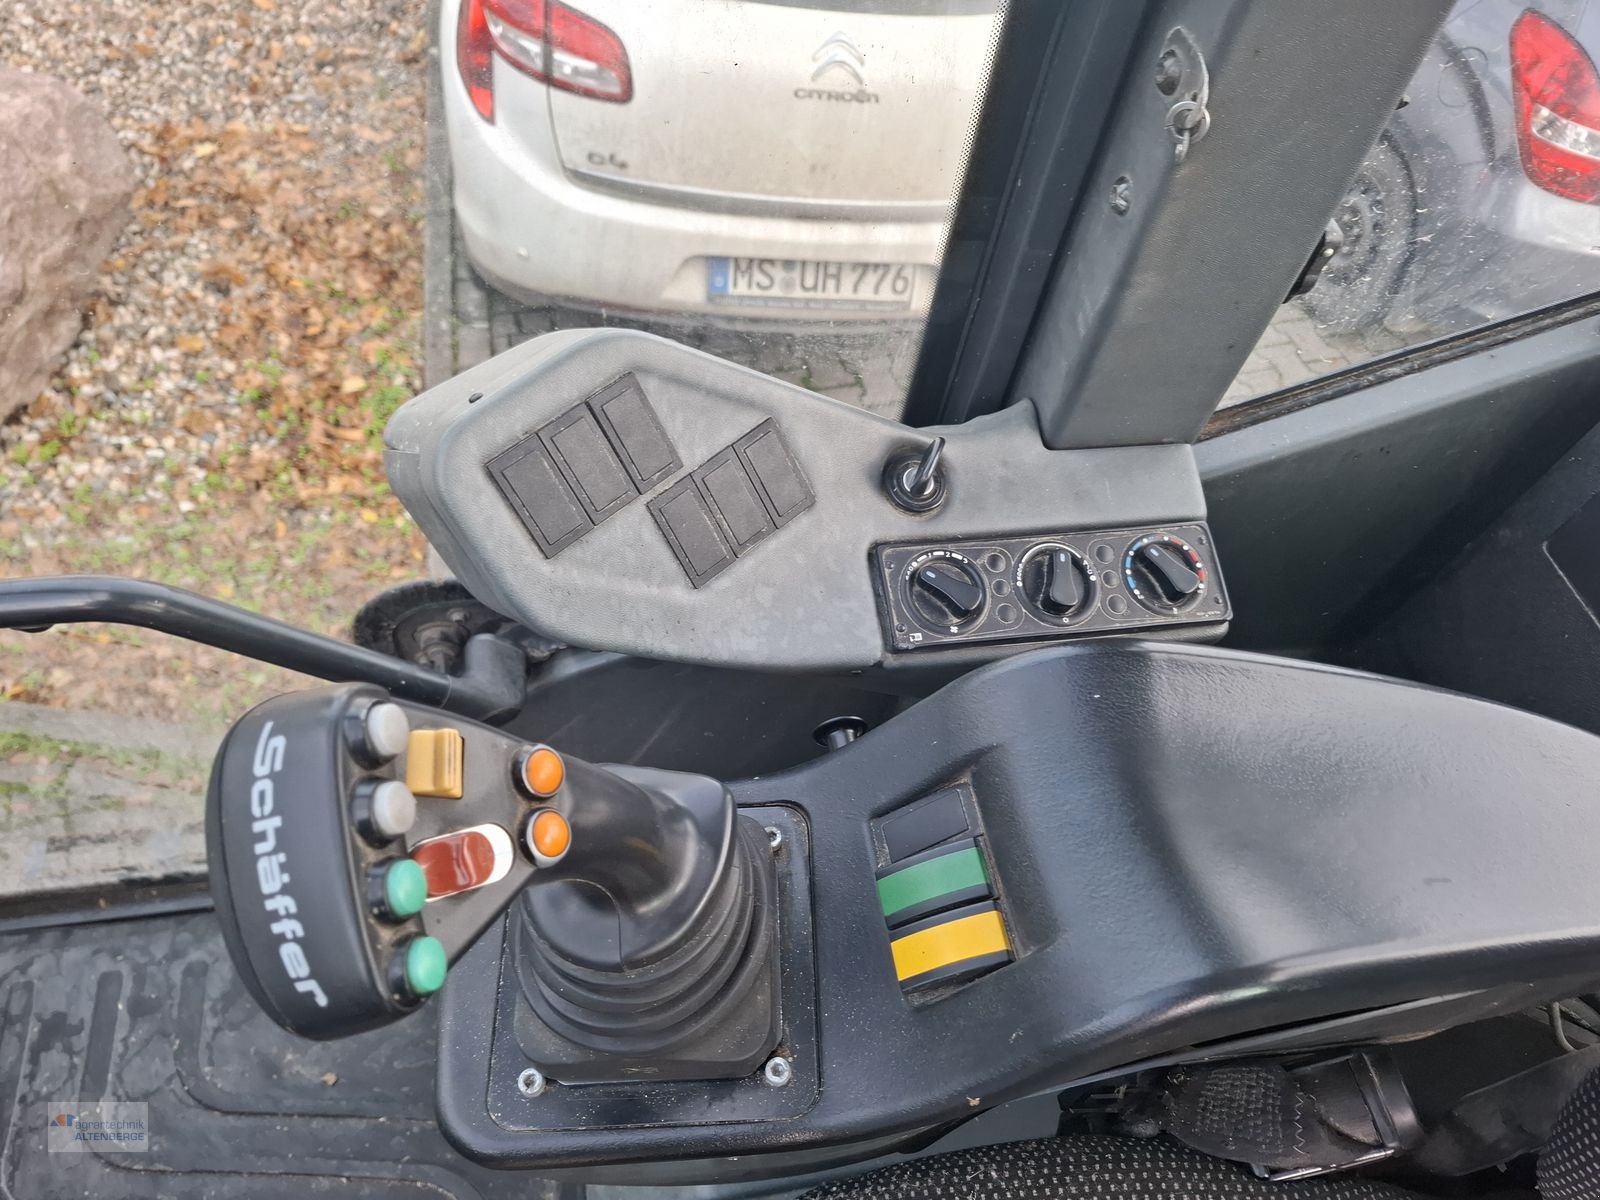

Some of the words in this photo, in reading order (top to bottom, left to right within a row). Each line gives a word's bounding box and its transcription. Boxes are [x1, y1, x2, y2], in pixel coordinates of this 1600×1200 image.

[733, 258, 776, 290] MS
[800, 260, 842, 293] UH
[852, 263, 910, 295] 776
[251, 721, 328, 1007] Schäffer
